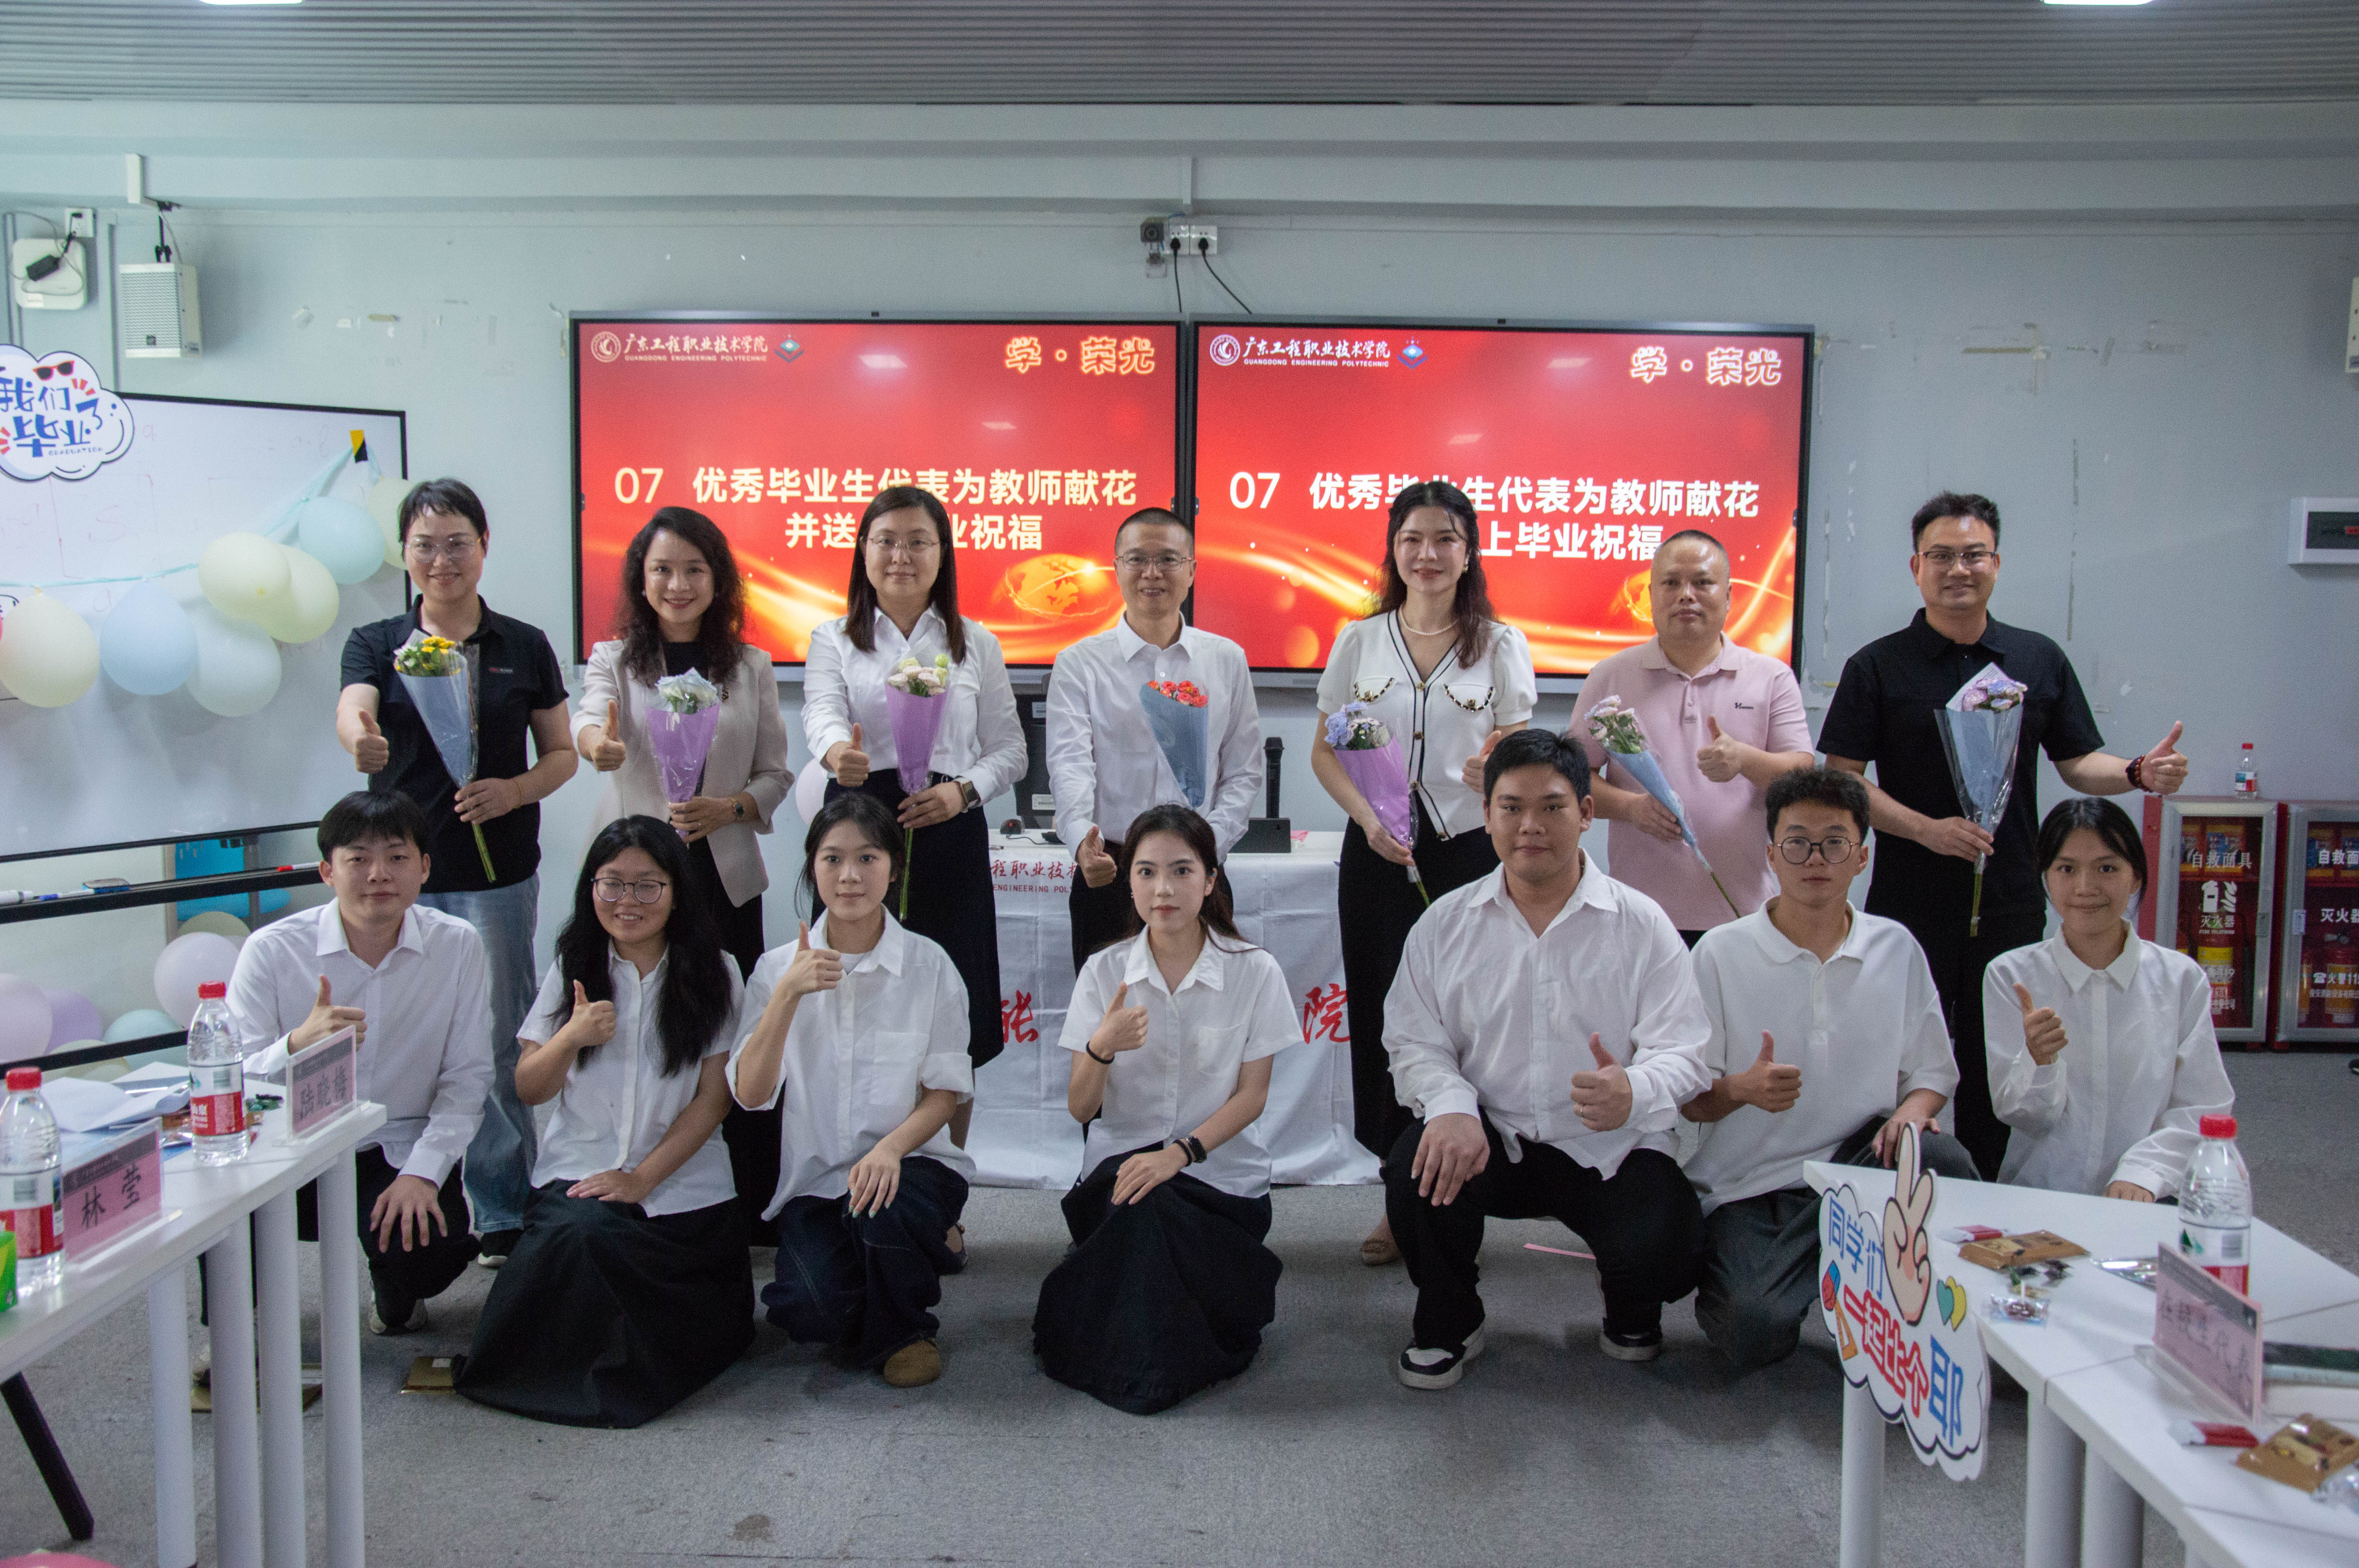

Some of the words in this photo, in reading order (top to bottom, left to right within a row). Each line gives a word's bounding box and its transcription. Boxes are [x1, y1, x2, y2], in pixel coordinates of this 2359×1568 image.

[623, 333, 768, 354] 广东工程职业技术学院
[1243, 336, 1390, 358] 广东工程职业技术学院
[614, 468, 664, 503] 07
[1230, 472, 1280, 509] 07
[1310, 472, 1759, 517] 优秀毕生代表为教师献花
[2192, 851, 2252, 869] 自救面具
[2200, 915, 2235, 928] 灭火器
[1303, 983, 1351, 1044] 院
[1829, 1196, 1882, 1300] 同学们
